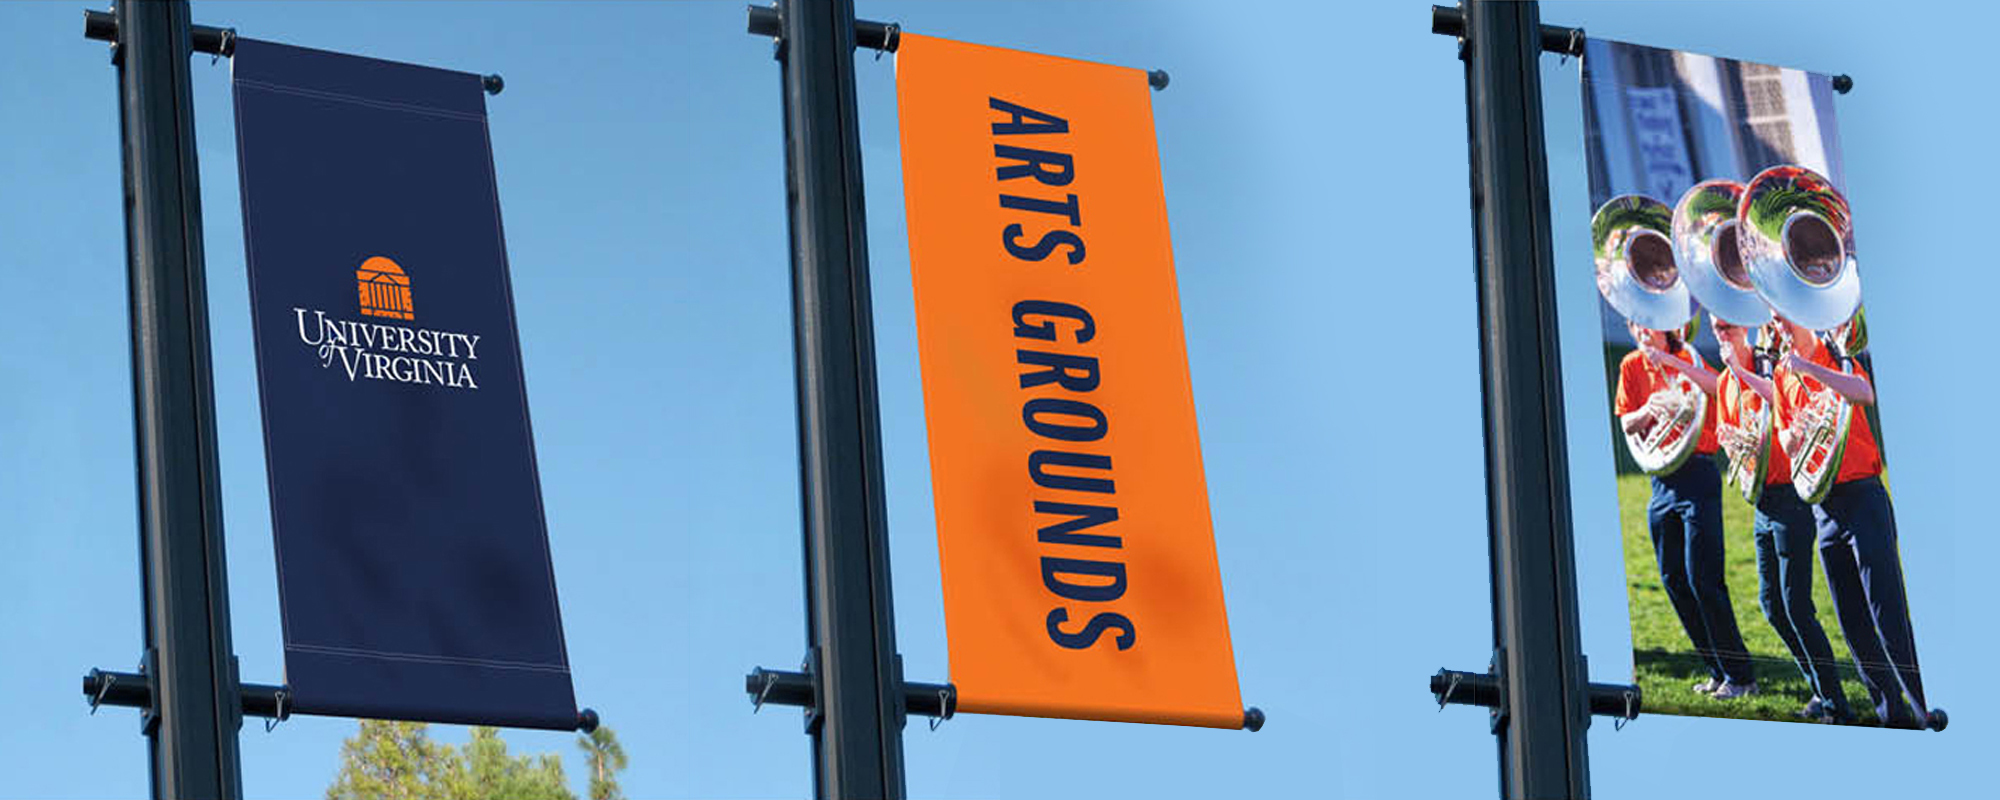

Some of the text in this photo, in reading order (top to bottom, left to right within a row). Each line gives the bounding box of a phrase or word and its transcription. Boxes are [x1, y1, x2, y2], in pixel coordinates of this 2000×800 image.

[293, 307, 480, 359] UNIVERSITY
[319, 337, 478, 389] of VIRGINIA
[988, 96, 1136, 652] ARTS GROUNDS
